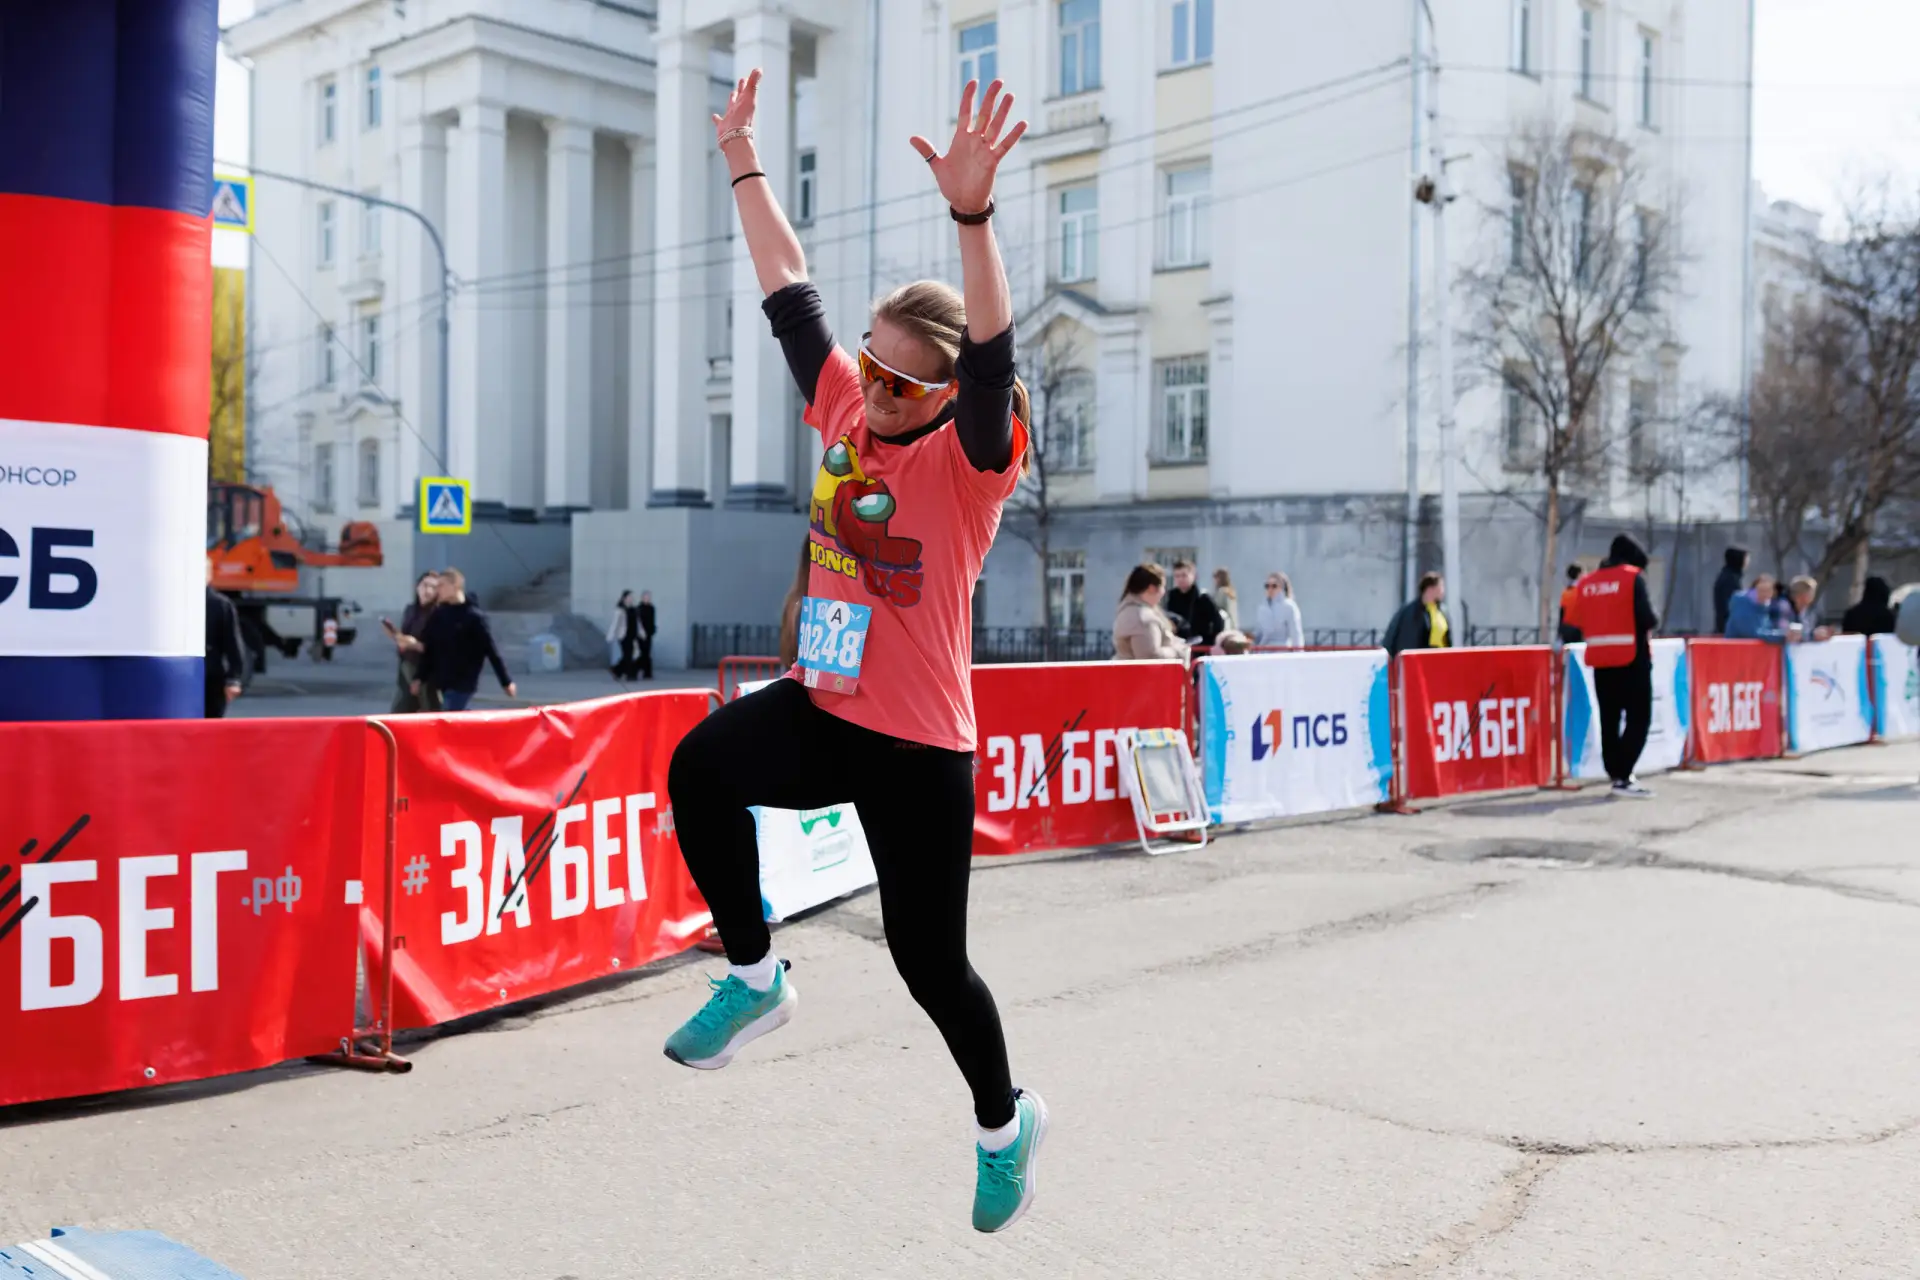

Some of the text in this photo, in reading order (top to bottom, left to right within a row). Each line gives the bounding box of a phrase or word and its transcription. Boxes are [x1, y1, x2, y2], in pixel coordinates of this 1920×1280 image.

[0, 526, 98, 610] Б
[798, 621, 862, 669] 30248
[1293, 713, 1348, 749] ПСБ
